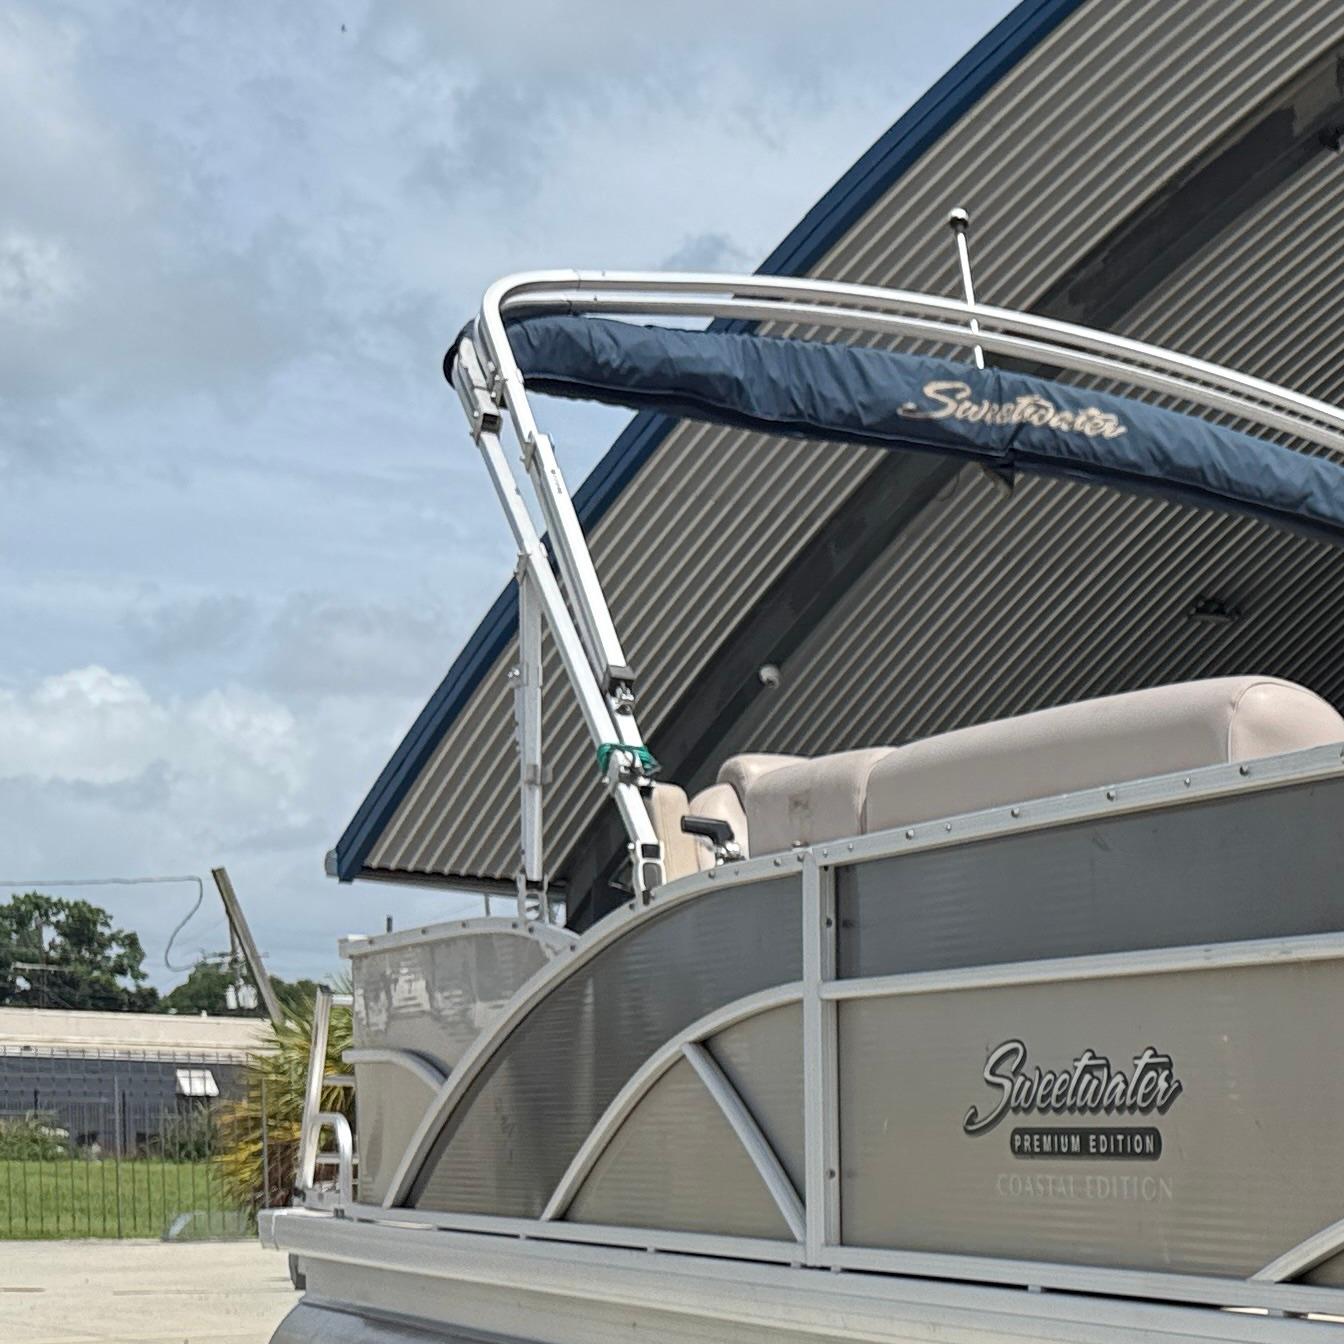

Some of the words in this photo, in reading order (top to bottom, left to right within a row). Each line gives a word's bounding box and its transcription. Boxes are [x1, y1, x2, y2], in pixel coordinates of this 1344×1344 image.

[897, 381, 1128, 439] Sweetwater
[963, 1039, 1183, 1138] Sweetwater
[1013, 1134, 1082, 1154] PREMIUM
[1089, 1134, 1155, 1154] EDITION
[1087, 1175, 1174, 1201] EDITION
